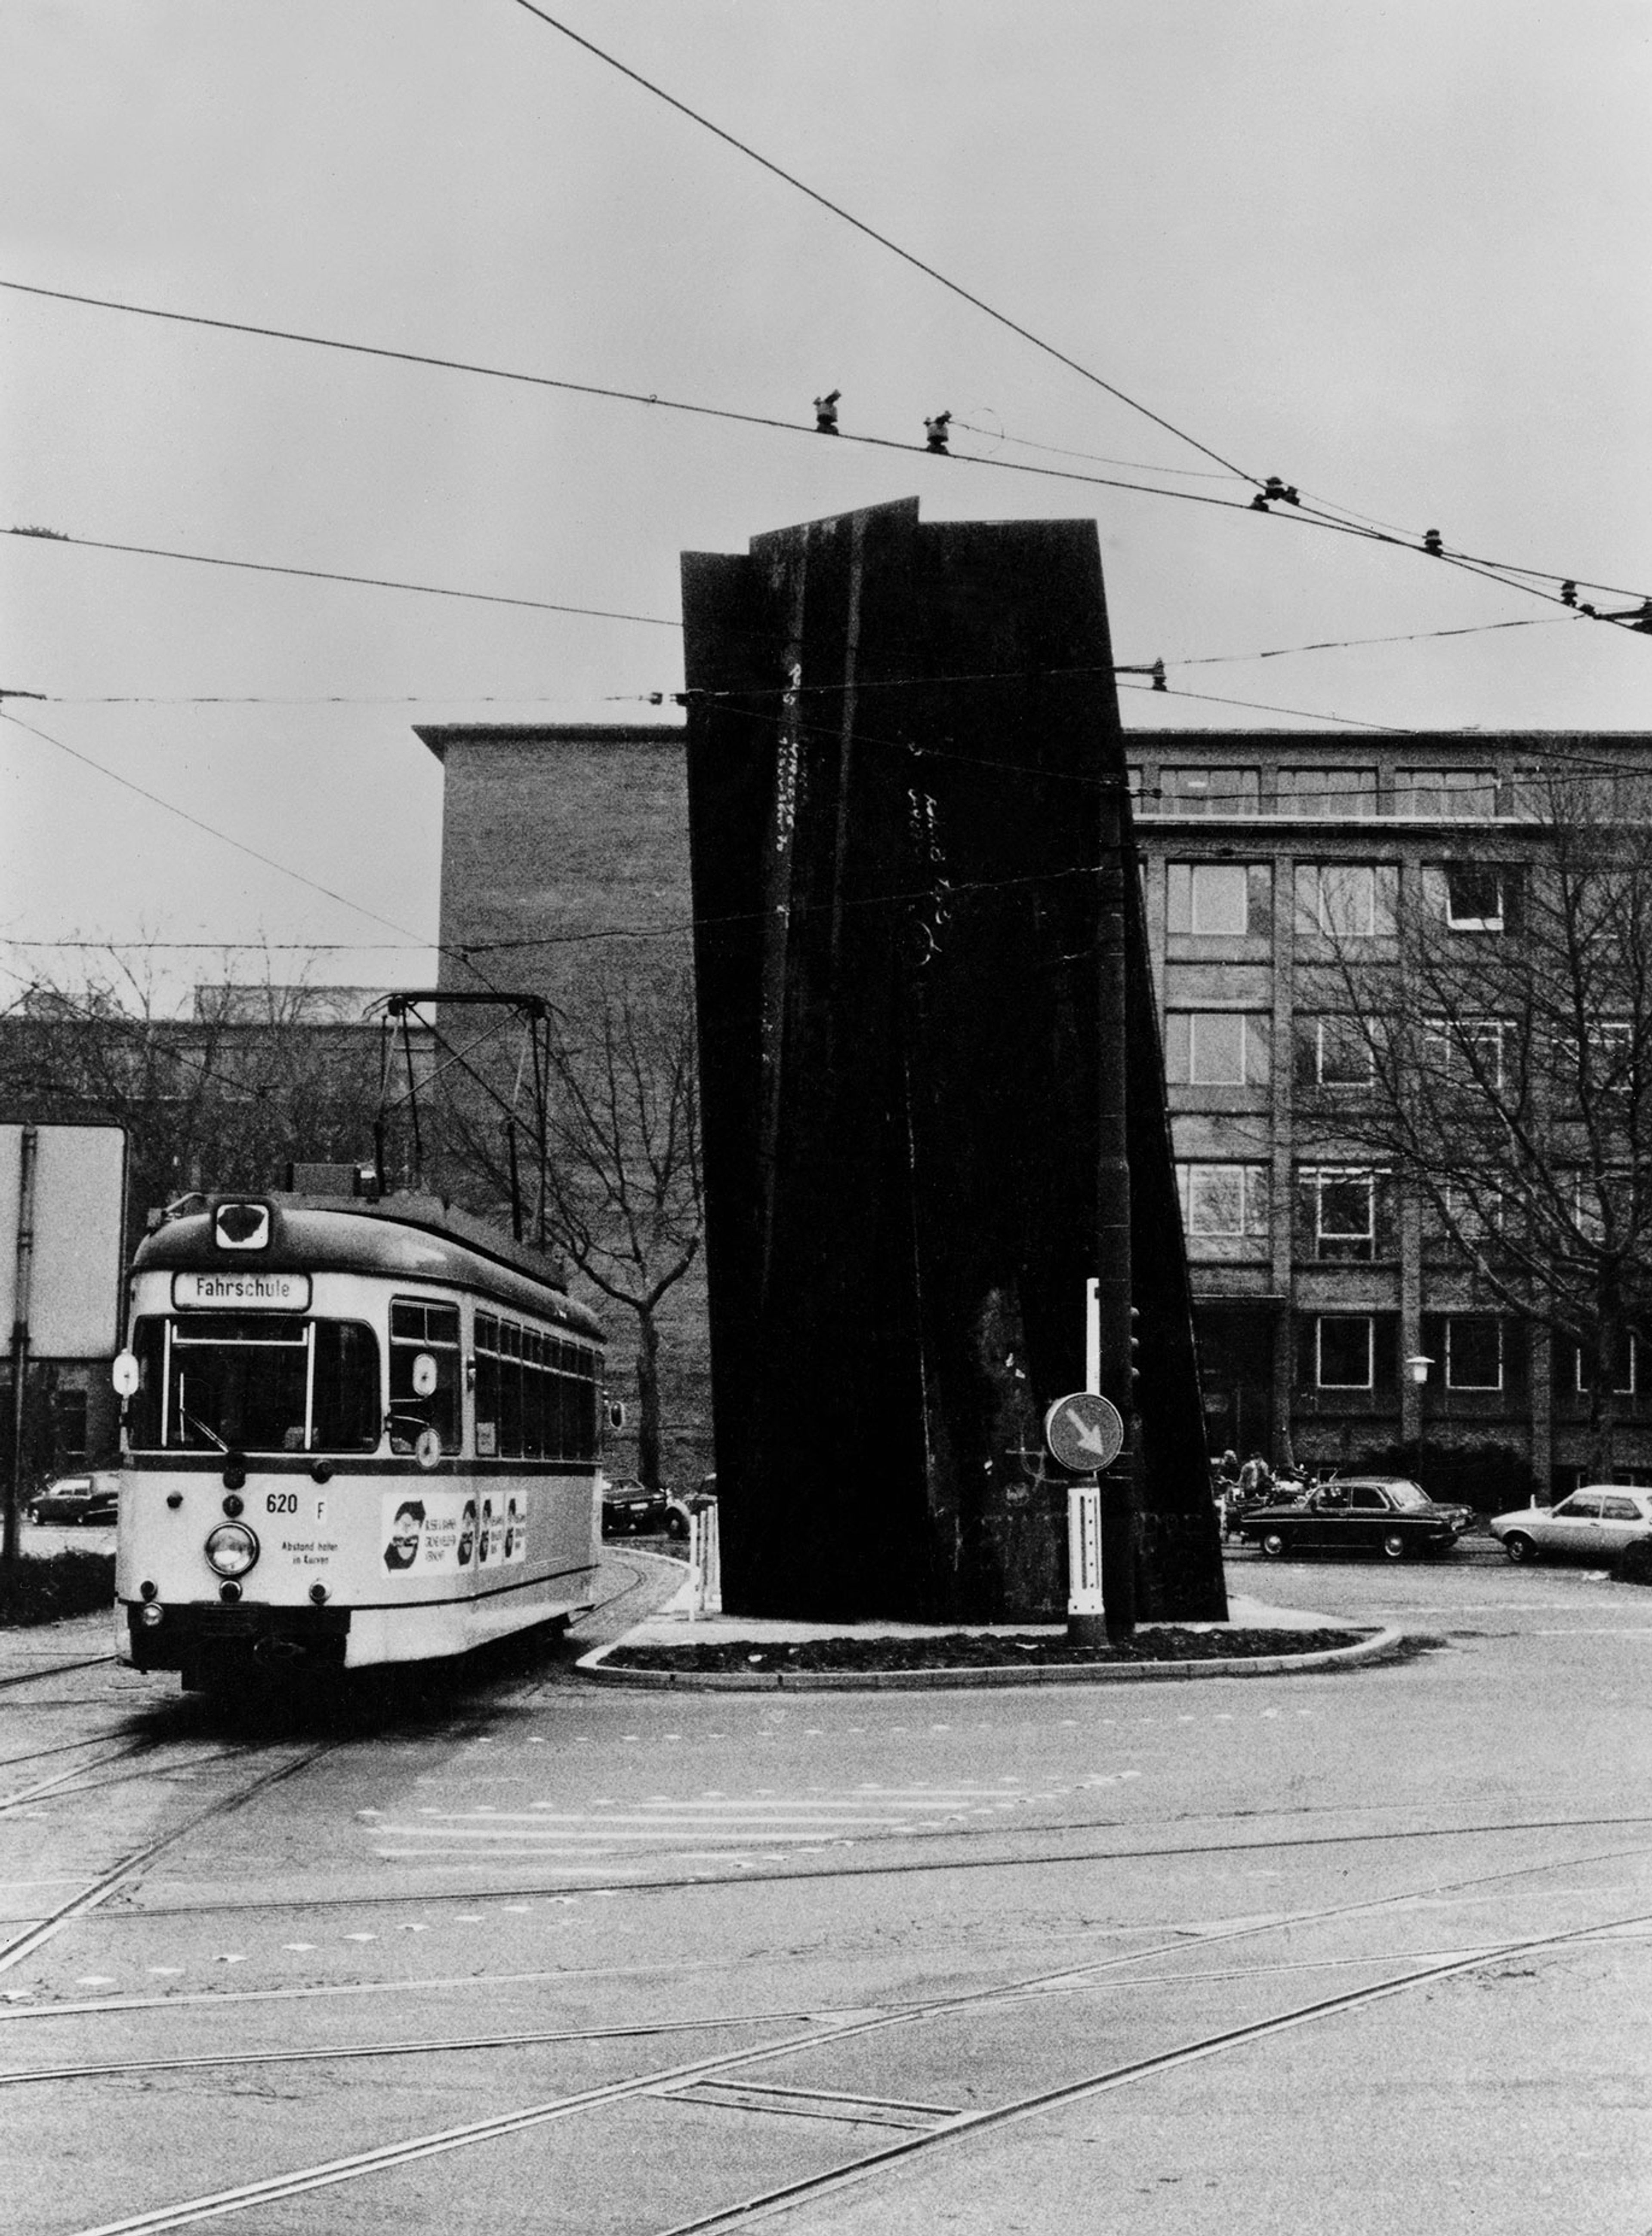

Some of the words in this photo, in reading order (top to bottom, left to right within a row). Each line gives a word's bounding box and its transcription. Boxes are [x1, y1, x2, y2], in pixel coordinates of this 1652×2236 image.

[197, 1277, 290, 1297] Fahrschule
[267, 1494, 298, 1514] 620
[317, 1502, 325, 1519] F
